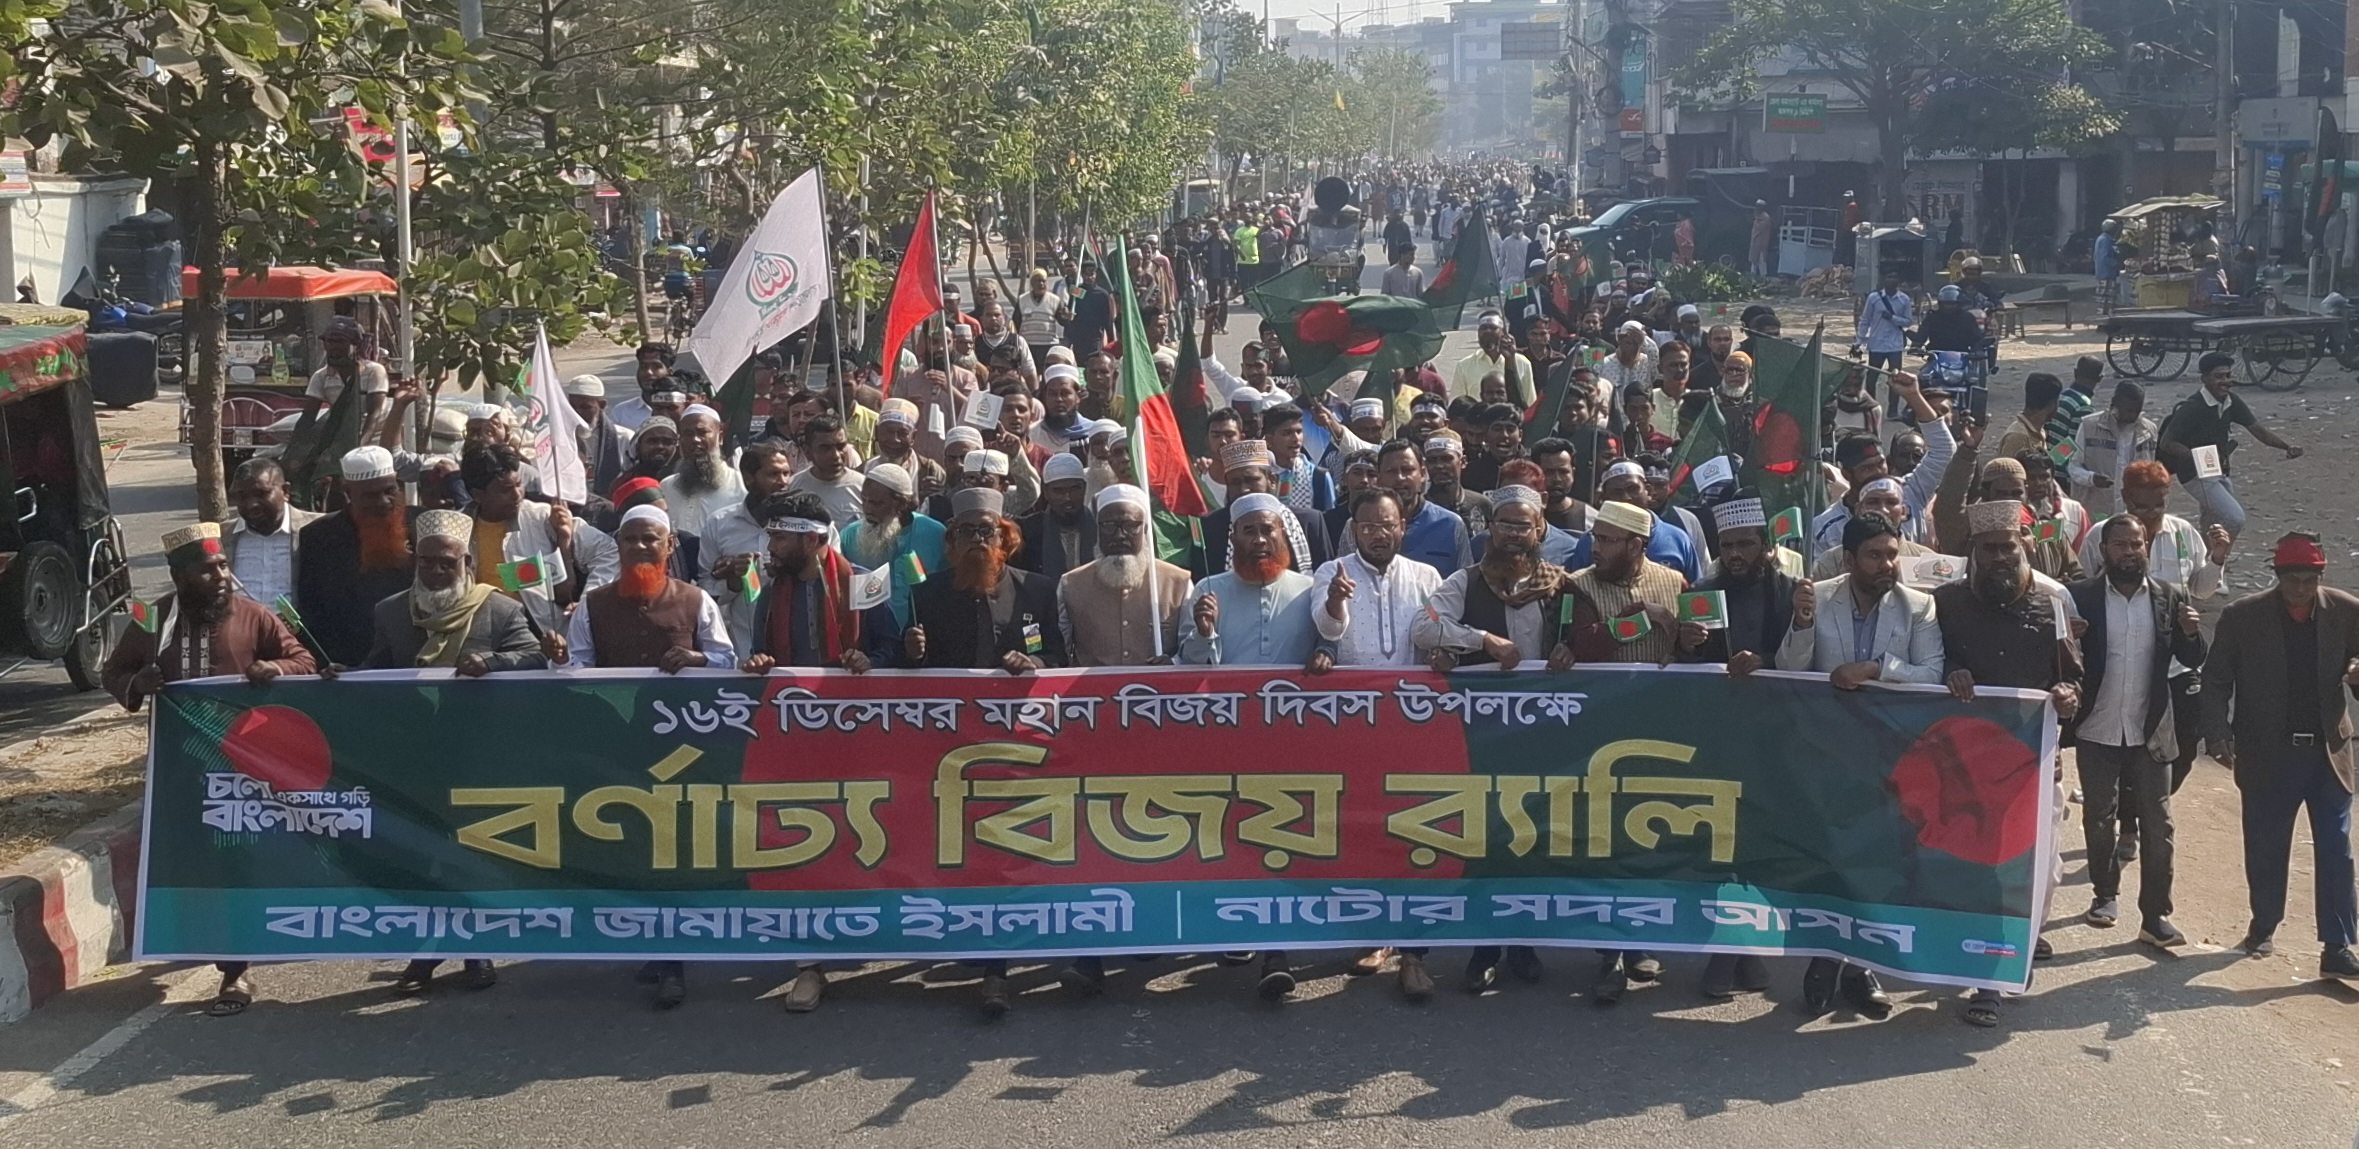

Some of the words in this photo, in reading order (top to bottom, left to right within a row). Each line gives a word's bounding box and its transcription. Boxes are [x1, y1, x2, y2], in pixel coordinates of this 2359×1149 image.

[652, 687, 760, 737] ১৬ই
[772, 683, 964, 734] ডিসেম্বর
[977, 693, 1104, 735] মহান
[1114, 683, 1245, 728] বিজয়
[1258, 679, 1382, 726] দিবস
[1396, 679, 1588, 726] উপলক্ষে
[206, 772, 274, 799] চলো
[275, 791, 337, 804] একসাথে
[341, 786, 371, 807] গড়ি
[450, 743, 890, 870] বর্ণাঢ্য
[934, 742, 1345, 871] বিজয়
[202, 800, 371, 838] বাংলাদেশ
[265, 906, 573, 940] বাংলাদেশ
[593, 906, 882, 942] জামায়াতে
[900, 888, 1135, 940] ইসলামী
[1215, 886, 1468, 926] নাটোর
[1491, 894, 1676, 927] সদর
[1700, 899, 1916, 953] আসন
